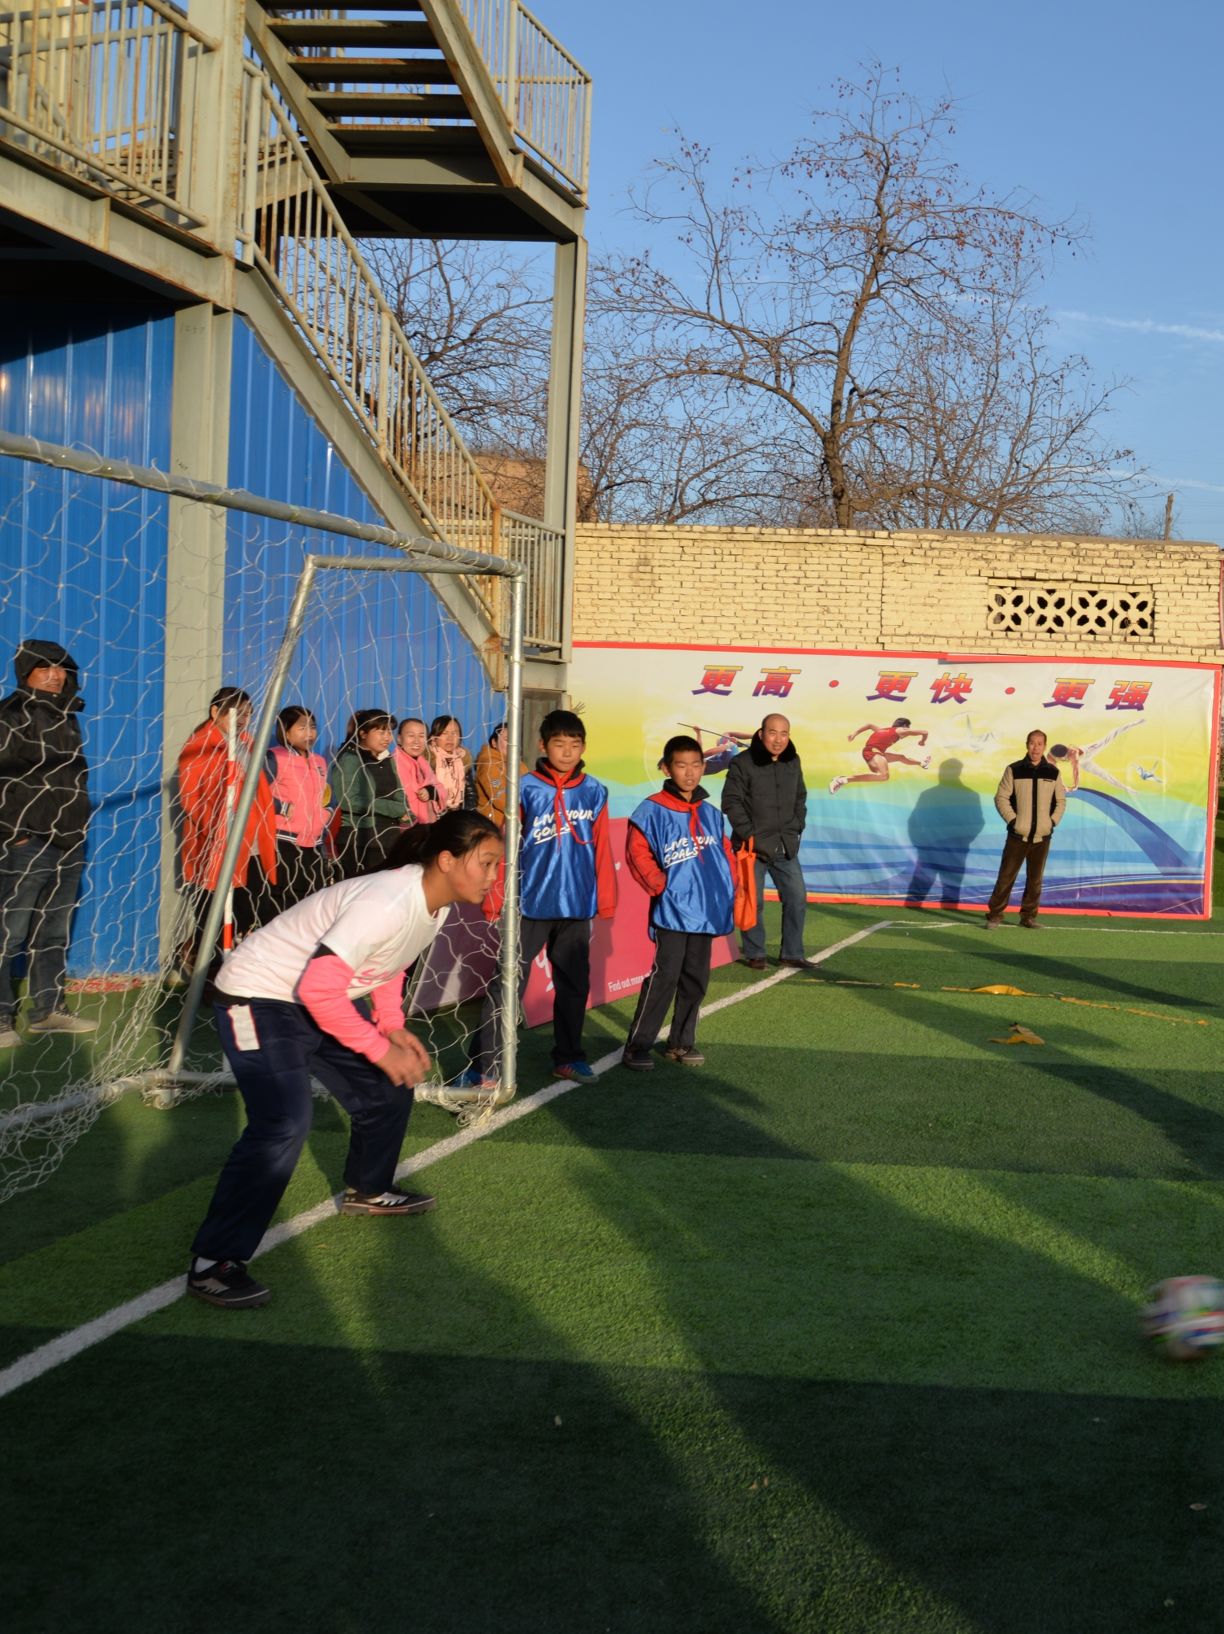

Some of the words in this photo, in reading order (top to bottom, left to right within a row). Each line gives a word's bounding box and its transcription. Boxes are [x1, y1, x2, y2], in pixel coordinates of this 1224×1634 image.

[533, 811, 562, 827] LIV
[565, 809, 594, 821] YOUR
[664, 837, 688, 852] LIVE
[664, 846, 704, 864] GOALS
[608, 979, 622, 992] Find
